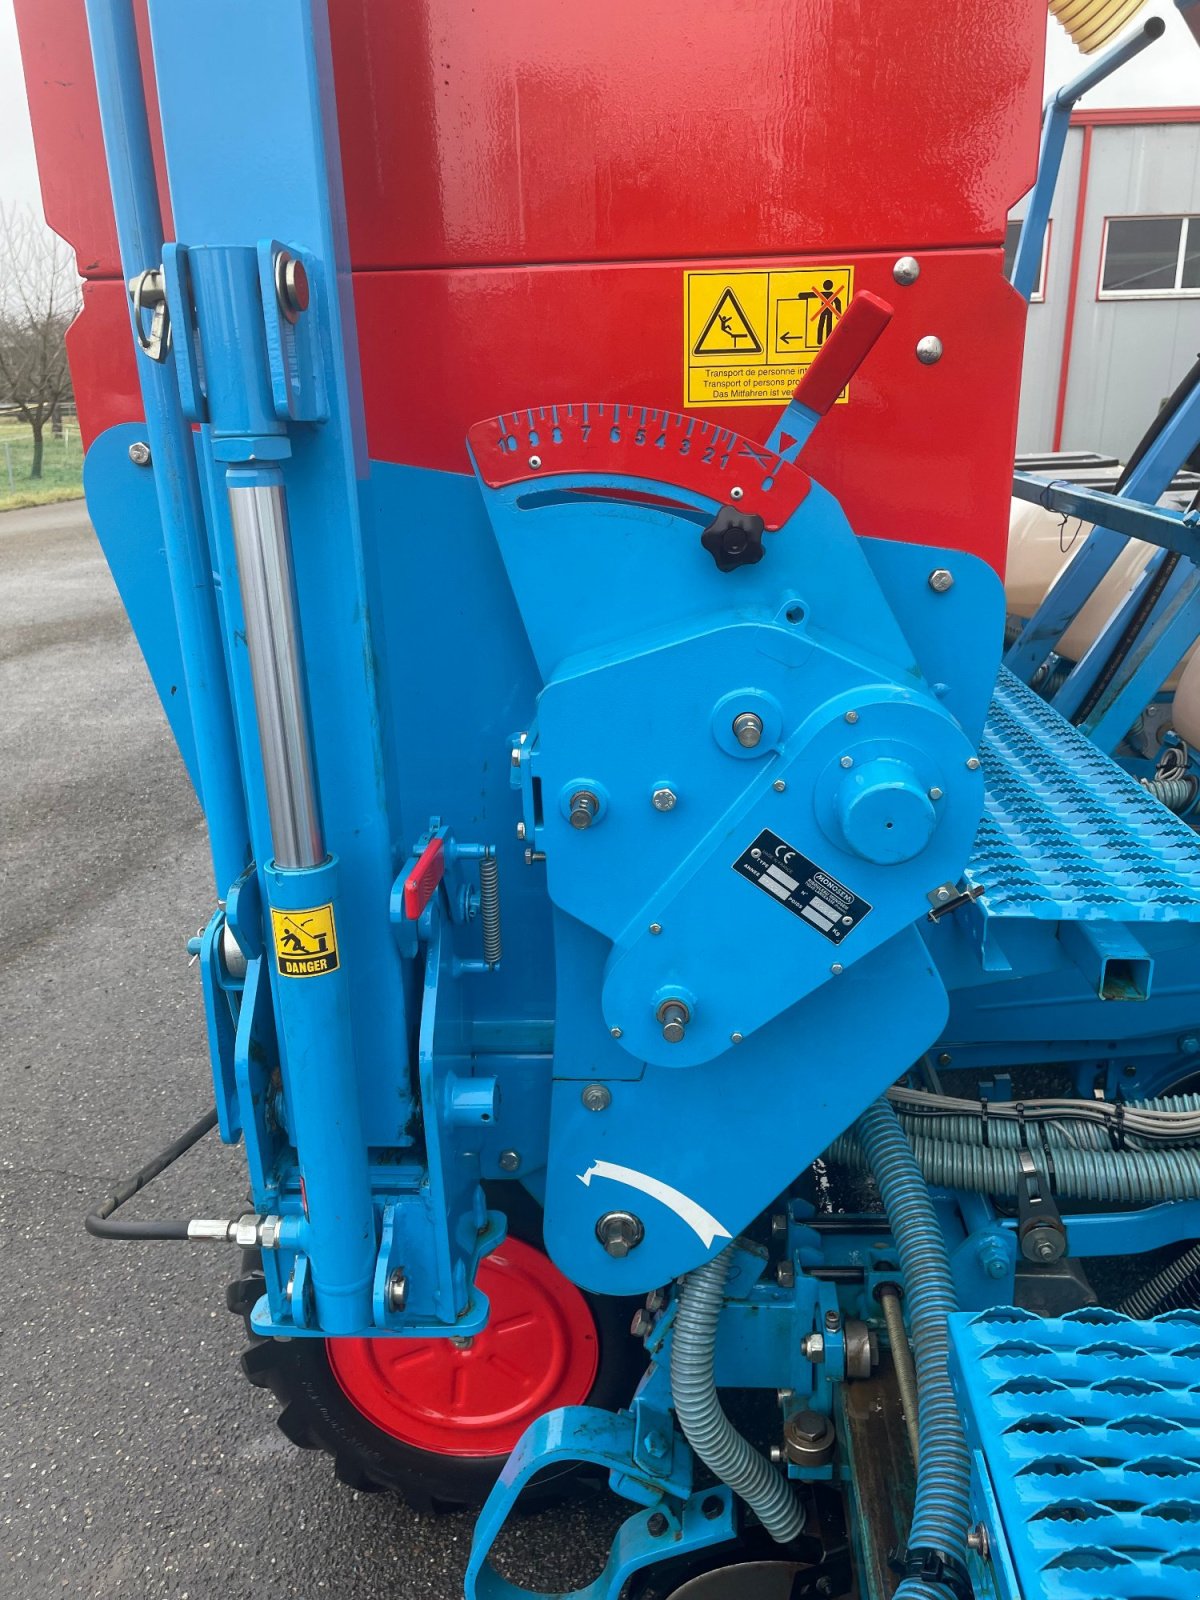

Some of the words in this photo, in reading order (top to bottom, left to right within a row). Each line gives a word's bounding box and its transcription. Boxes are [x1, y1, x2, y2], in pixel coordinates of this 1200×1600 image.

[705, 369, 743, 378] Transport
[758, 368, 795, 377] personne
[703, 380, 741, 389] Transport
[743, 379, 751, 387] of
[753, 379, 785, 387] persons
[713, 390, 729, 398] Das
[730, 389, 768, 397] Mitfahren
[770, 388, 779, 396] ist
[498, 434, 518, 454] 10
[552, 427, 563, 444] 8
[581, 425, 591, 443] 7
[609, 426, 621, 443] 6
[635, 429, 647, 446] 5
[655, 433, 667, 449] 4
[680, 438, 691, 455] 3
[702, 447, 716, 464] 2
[720, 454, 730, 470] 1
[756, 857, 769, 868] TYPE
[815, 873, 852, 903] MONOSEM
[788, 897, 803, 909] POIDS
[832, 928, 841, 937] Kg
[285, 958, 328, 973] DANGER
